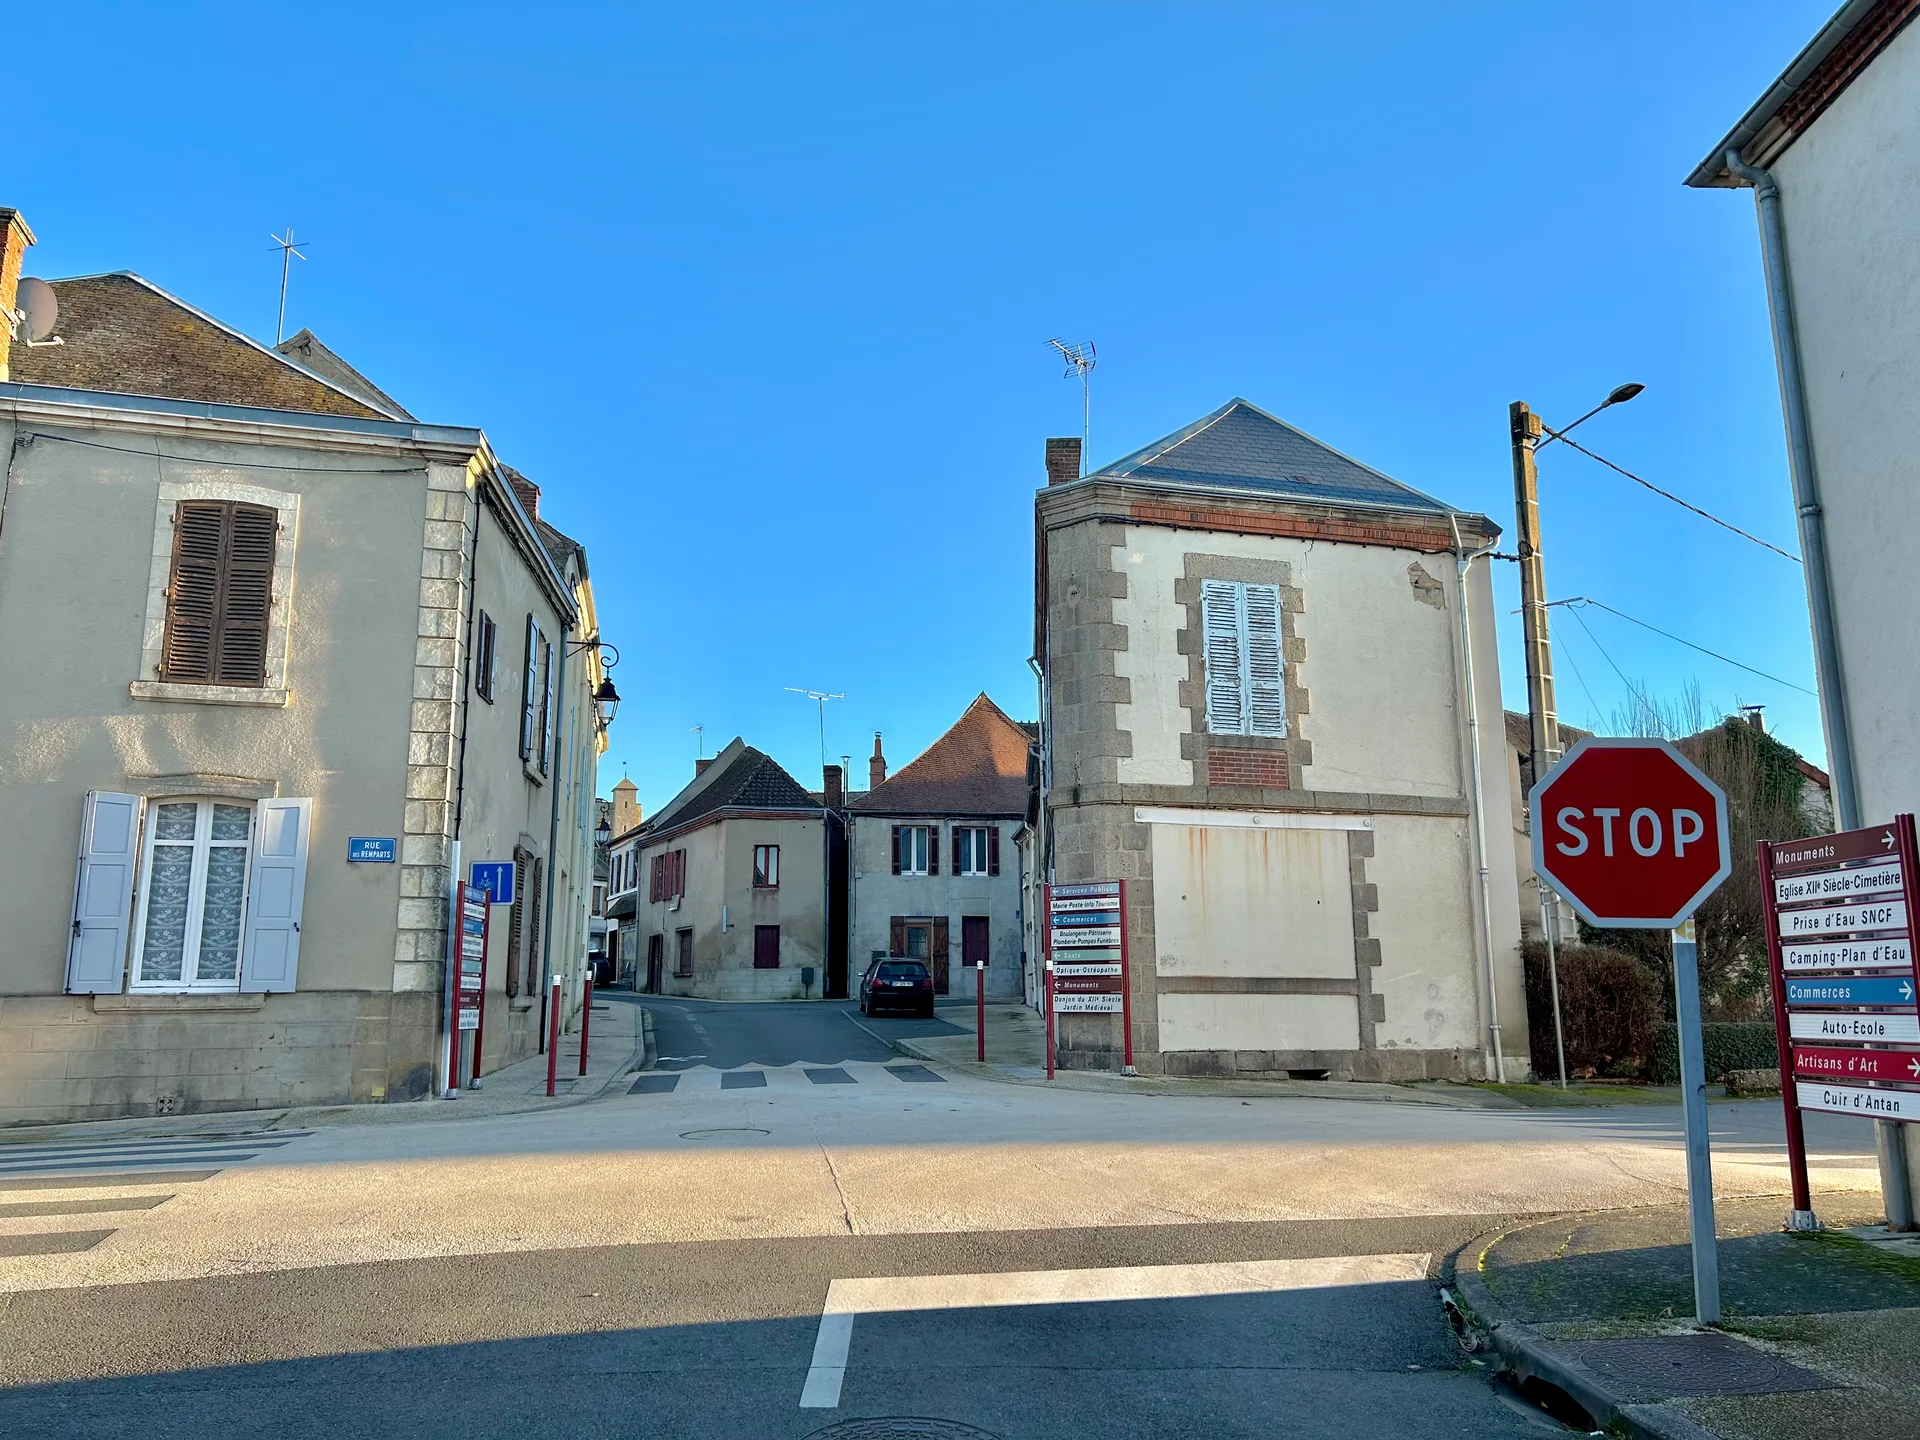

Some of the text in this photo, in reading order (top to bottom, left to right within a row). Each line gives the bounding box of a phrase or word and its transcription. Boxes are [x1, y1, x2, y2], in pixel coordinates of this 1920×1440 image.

[1555, 806, 1704, 857] STOP
[1775, 845, 1835, 865] Monuments
[1779, 883, 1804, 901] Eglise
[1793, 908, 1892, 930] Prise d'Eau SNCF
[1789, 946, 1905, 967] Camping-Plan d'Eau
[1063, 981, 1099, 989] Monuments
[1789, 985, 1851, 999] Commerces
[1054, 995, 1075, 1003] Donjon
[1101, 995, 1121, 1003] Siècle
[1822, 1020, 1885, 1035] Auto-Ecole
[1797, 1054, 1878, 1073] Artisans d'Art
[1823, 1090, 1900, 1112] Cuir d'Antan
